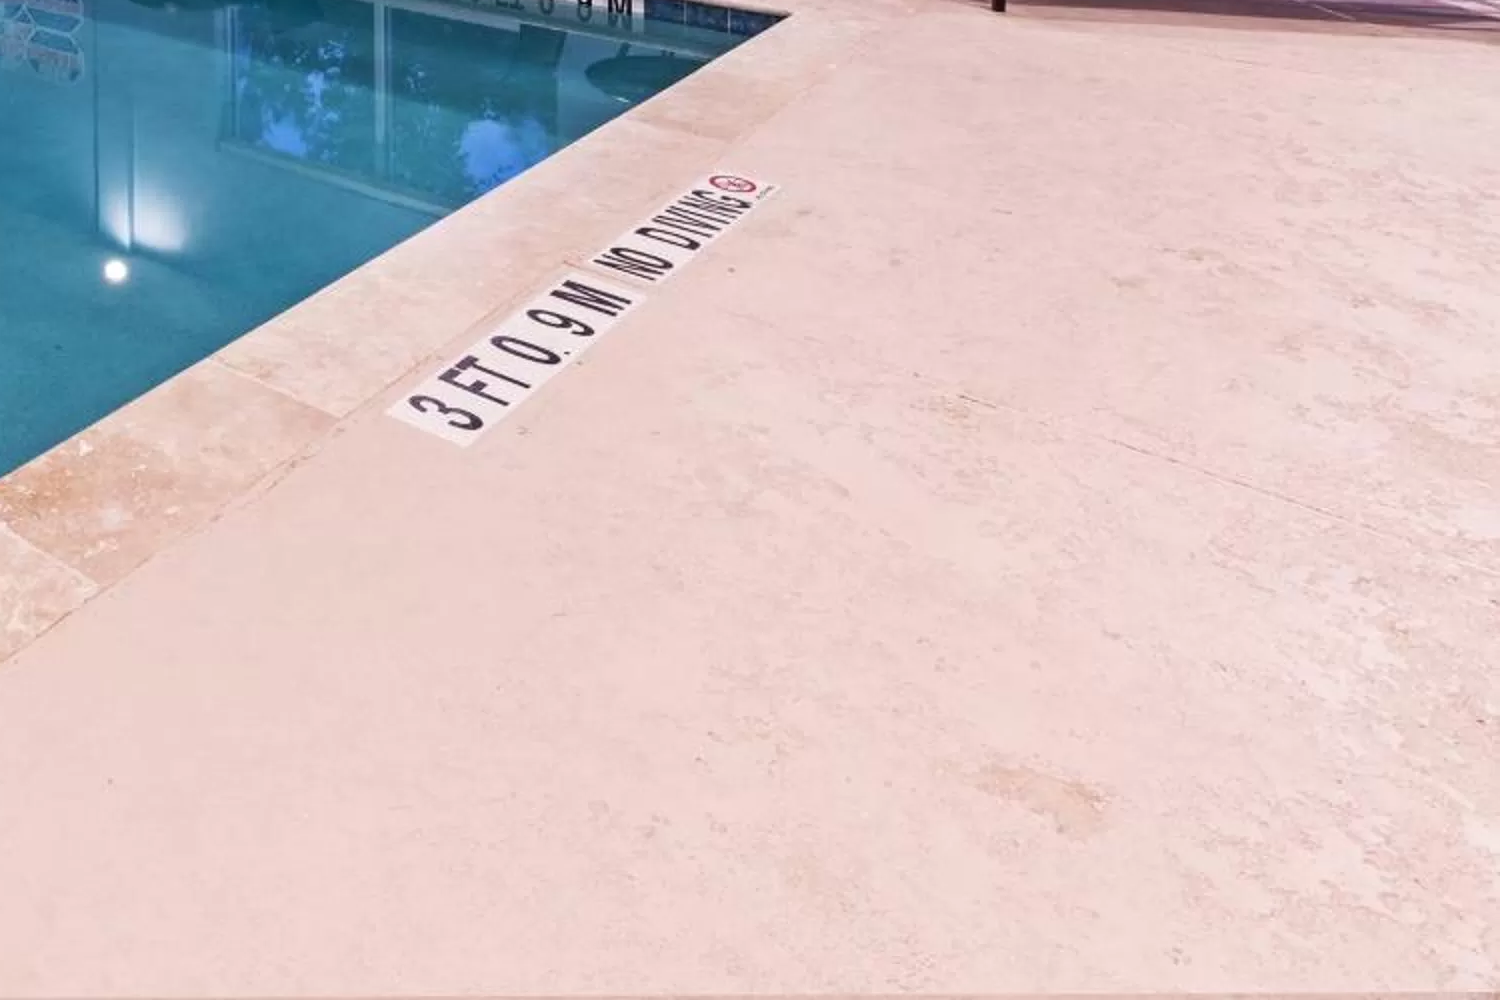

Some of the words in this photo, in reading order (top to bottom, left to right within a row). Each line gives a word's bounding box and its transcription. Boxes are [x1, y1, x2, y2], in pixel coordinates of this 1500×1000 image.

[593, 246, 674, 281] NO
[634, 188, 752, 251] DIVING
[549, 279, 632, 317] M
[437, 355, 531, 407] FT
[408, 394, 484, 431] 3
